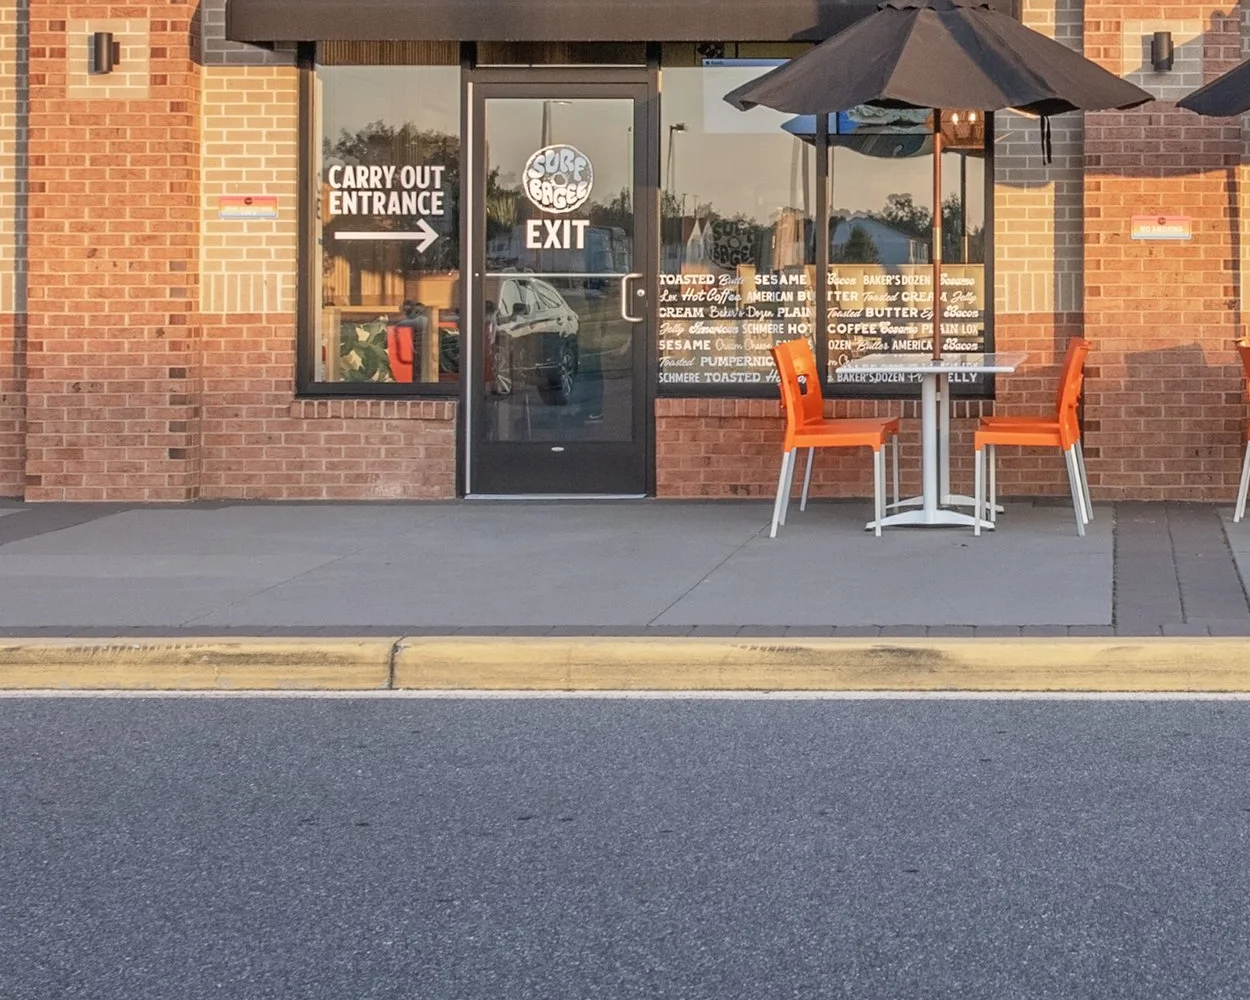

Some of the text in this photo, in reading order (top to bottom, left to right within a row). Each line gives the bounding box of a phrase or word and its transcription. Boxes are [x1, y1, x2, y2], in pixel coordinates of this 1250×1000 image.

[527, 149, 587, 181] SURF
[328, 165, 445, 189] CARRY OUT
[529, 179, 588, 208] BAGEL
[329, 191, 445, 215] ENTRANCE
[526, 220, 590, 249] EXIT
[659, 274, 715, 285] TOASTED
[754, 274, 808, 285] SESAME
[863, 275, 900, 285] BAKER'S
[902, 275, 931, 285] DOZEN
[682, 288, 706, 301] Hot
[706, 287, 742, 304] Coffee
[747, 291, 793, 301] AMERICAN
[863, 292, 899, 303] Toasted
[951, 291, 977, 305] Jelly
[659, 307, 704, 318] CREAM
[708, 306, 744, 318] Baker's
[746, 306, 774, 322] Dozen
[865, 308, 918, 319] BUTTER
[920, 307, 934, 320] Eg
[943, 305, 979, 318] Bacon
[659, 322, 685, 335] Jelly
[742, 323, 784, 334] SCHMERE
[827, 323, 877, 334] COFFEE
[961, 323, 979, 334] LOX
[659, 340, 711, 350] SESAME
[892, 340, 933, 350] AMERICA
[942, 337, 978, 350] Bacon
[659, 356, 776, 367] Toasted PUMPERNIC
[659, 373, 700, 383] SCHMERE
[704, 372, 761, 383] TOASTED
[837, 373, 874, 383] BAKER'S
[875, 373, 904, 383] DOZEN
[948, 372, 977, 383] ELLY
